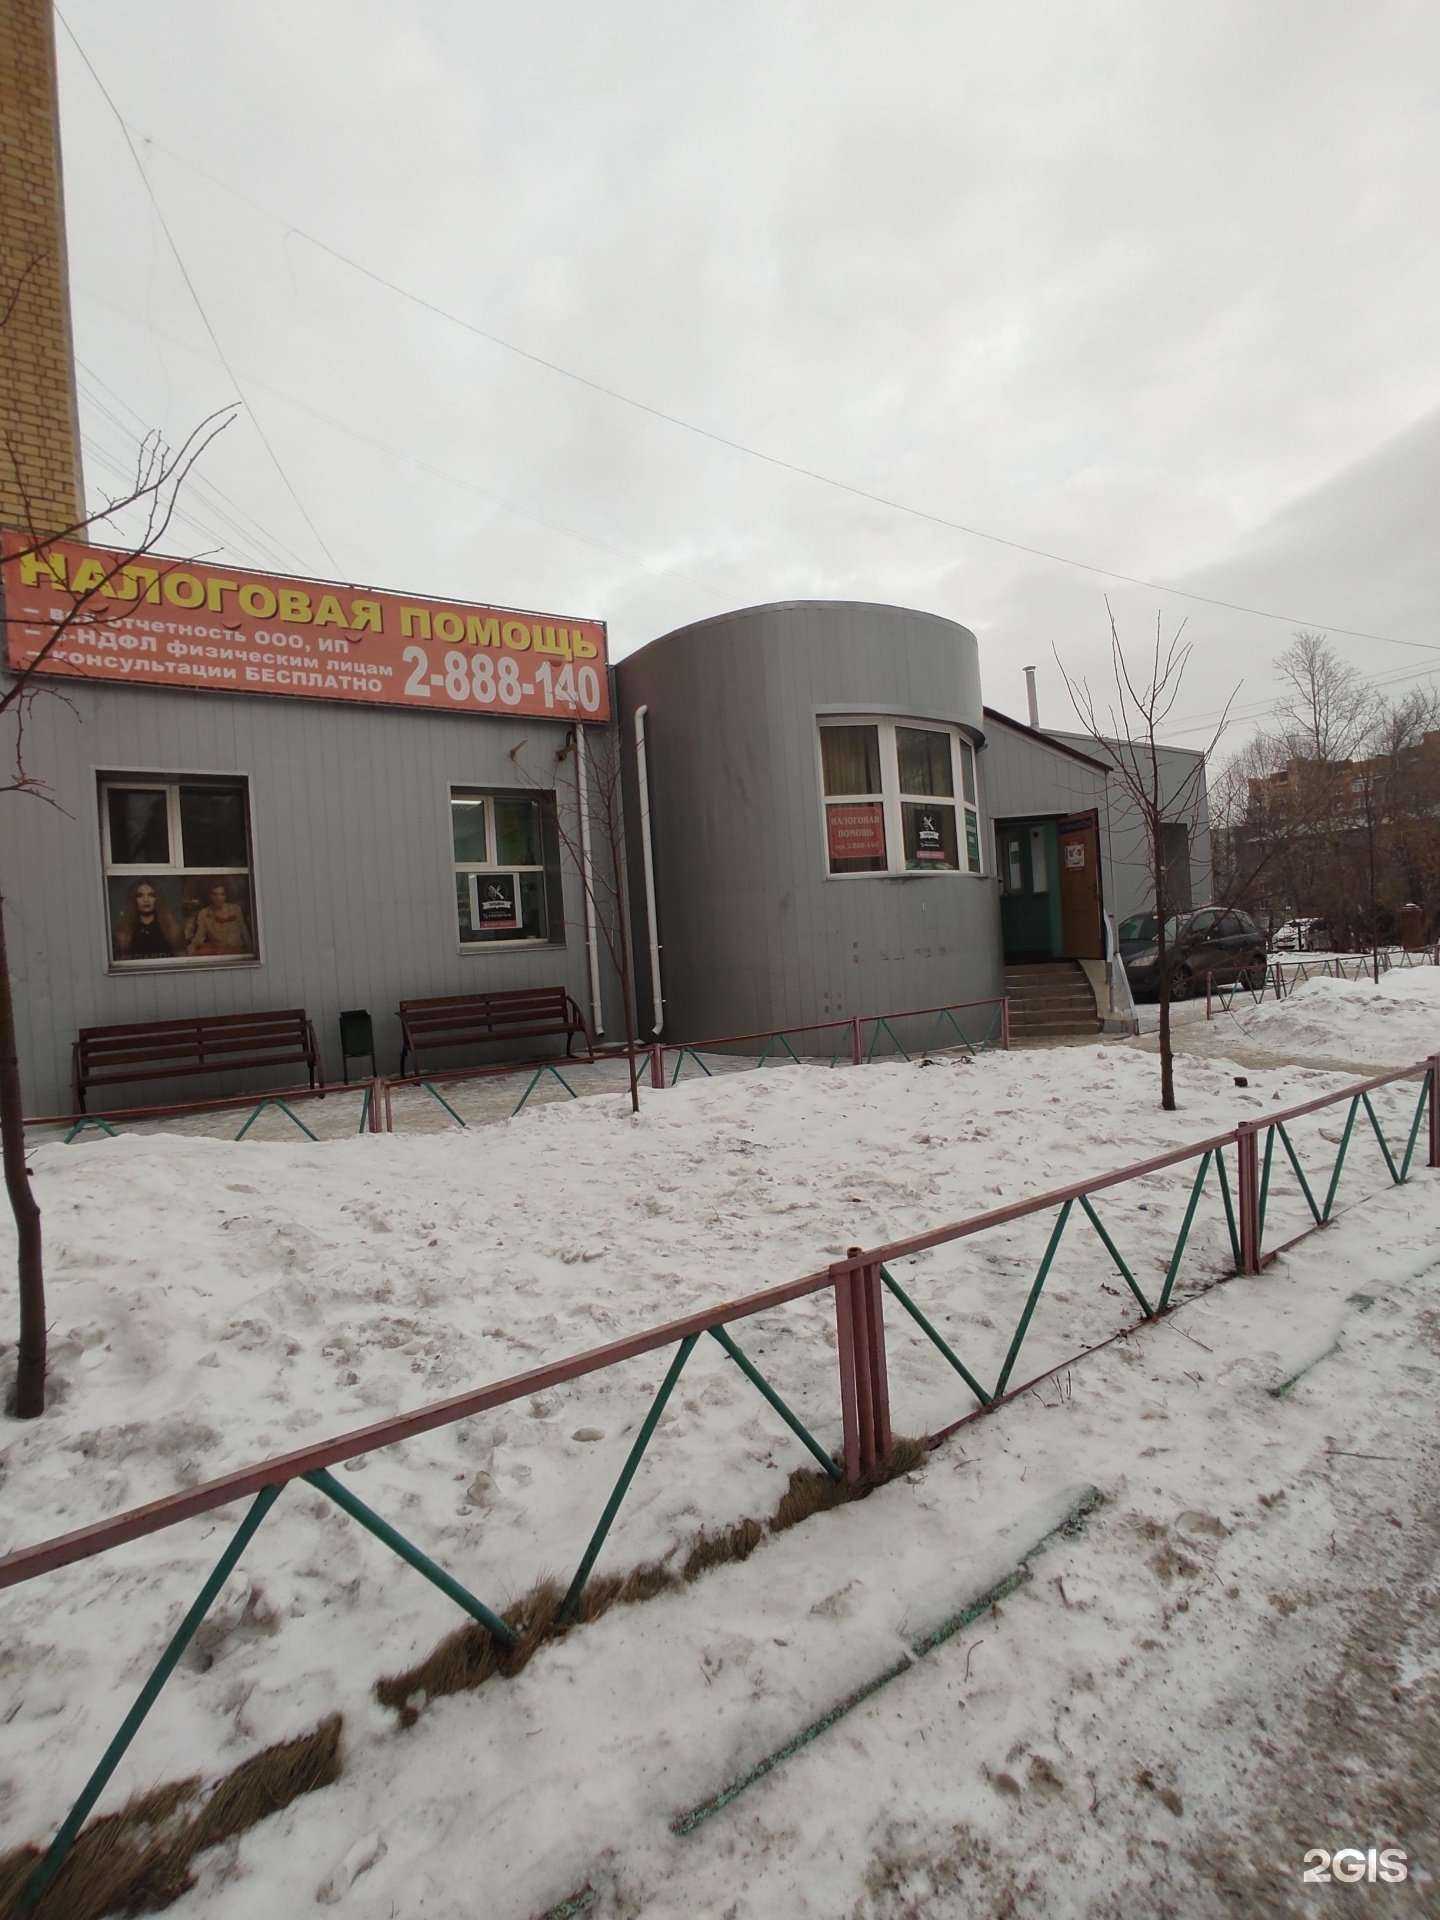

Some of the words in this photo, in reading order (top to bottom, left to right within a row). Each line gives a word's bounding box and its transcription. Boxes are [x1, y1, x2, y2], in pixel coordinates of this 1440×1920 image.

[19, 547, 383, 633] НАЛОГОВАЯ
[399, 606, 599, 662] ПОМОЩЬ
[106, 616, 247, 643] отчетность
[254, 630, 310, 652] ООО,
[51, 650, 237, 679] консультации
[245, 666, 383, 692] БЕСПЛАТНО
[166, 639, 319, 670] физическим
[325, 659, 393, 677] лицам
[402, 645, 600, 713] 2-888-140
